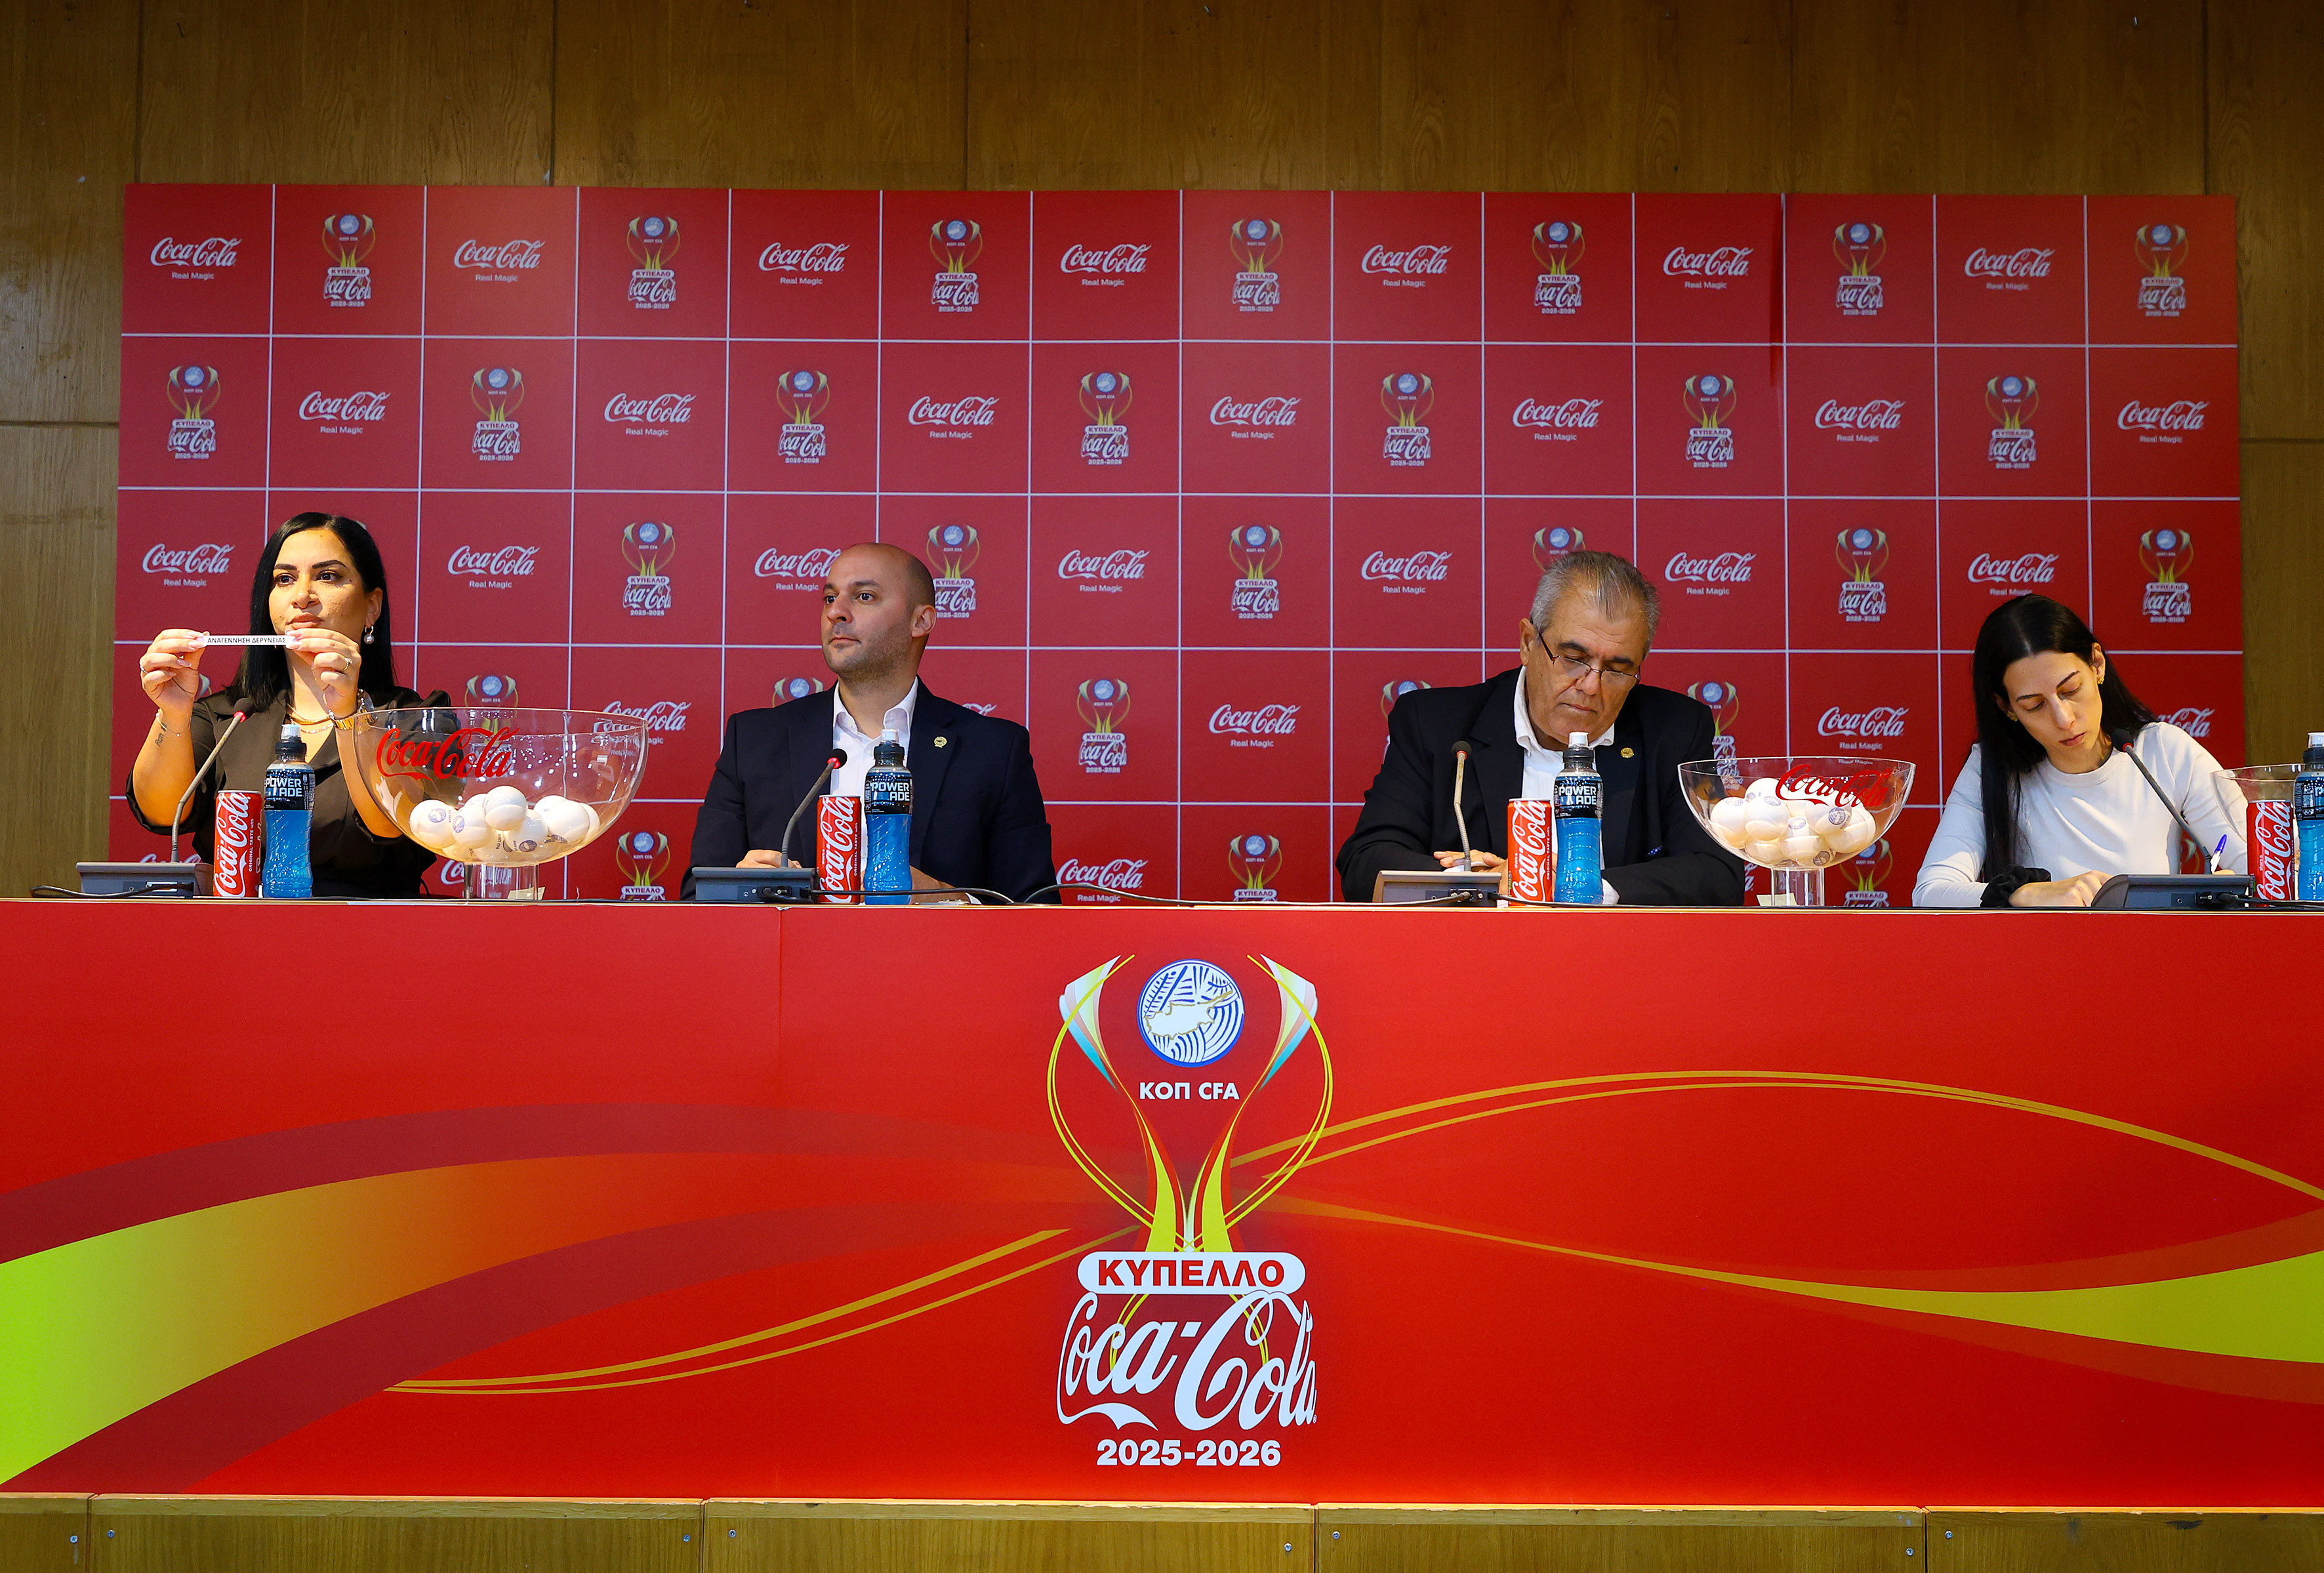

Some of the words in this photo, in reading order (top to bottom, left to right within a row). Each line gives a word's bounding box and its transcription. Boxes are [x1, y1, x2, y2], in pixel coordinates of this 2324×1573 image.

[151, 237, 243, 267] Coca-Cola
[454, 240, 546, 269] Coca-Cola
[759, 243, 851, 272] Coca-Cola
[1061, 244, 1152, 274] Coca-Cola
[1362, 245, 1453, 274] Coca-Cola
[1663, 247, 1755, 276] Coca-Cola
[1965, 248, 2056, 277] Coca-Cola
[299, 391, 392, 421] Coca-Cola
[604, 393, 697, 423] Coca-Cola
[908, 396, 1000, 426] Coca-Cola
[1210, 396, 1301, 426] Coca-Cola
[1513, 398, 1604, 428] Coca-Cola
[1815, 399, 1906, 429] Coca-Cola
[2118, 400, 2210, 430] Coca-Cola
[142, 544, 236, 573] Coca-Cola
[448, 546, 541, 575] Coca-Cola
[1059, 550, 1151, 579] Coca-Cola
[1362, 551, 1454, 581] Coca-Cola
[1665, 552, 1757, 582] Coca-Cola
[1968, 553, 2060, 583] Coca-Cola
[489, 581, 512, 589] Magic
[1209, 705, 1302, 734] Coca-Cola
[1818, 706, 1910, 737] Coca-Cola
[376, 726, 520, 781] Coca-Cola
[1859, 742, 1882, 750] Magic
[266, 777, 301, 787] POWER
[279, 787, 302, 796] ADE
[871, 782, 909, 791] POWER
[889, 792, 910, 801] ADE
[1559, 786, 1597, 796] POWER
[1576, 796, 1597, 805] ADE
[215, 792, 251, 897] Coca-Cola
[820, 797, 855, 903] Coca-Cola
[1512, 800, 1547, 902] Coca-Cola
[2255, 802, 2291, 900] Coca-Cola
[1057, 859, 1149, 889] Coca-Cola
[1097, 895, 1120, 903] Magic
[1139, 1083, 1190, 1100] ΚΟΠ
[1199, 1083, 1239, 1100] CFA
[1098, 1259, 1284, 1287] ΚΥΠΕΛΛΟ
[1057, 1290, 1317, 1431] Coca-Cola
[1097, 1439, 1281, 1467] 2025-2026
